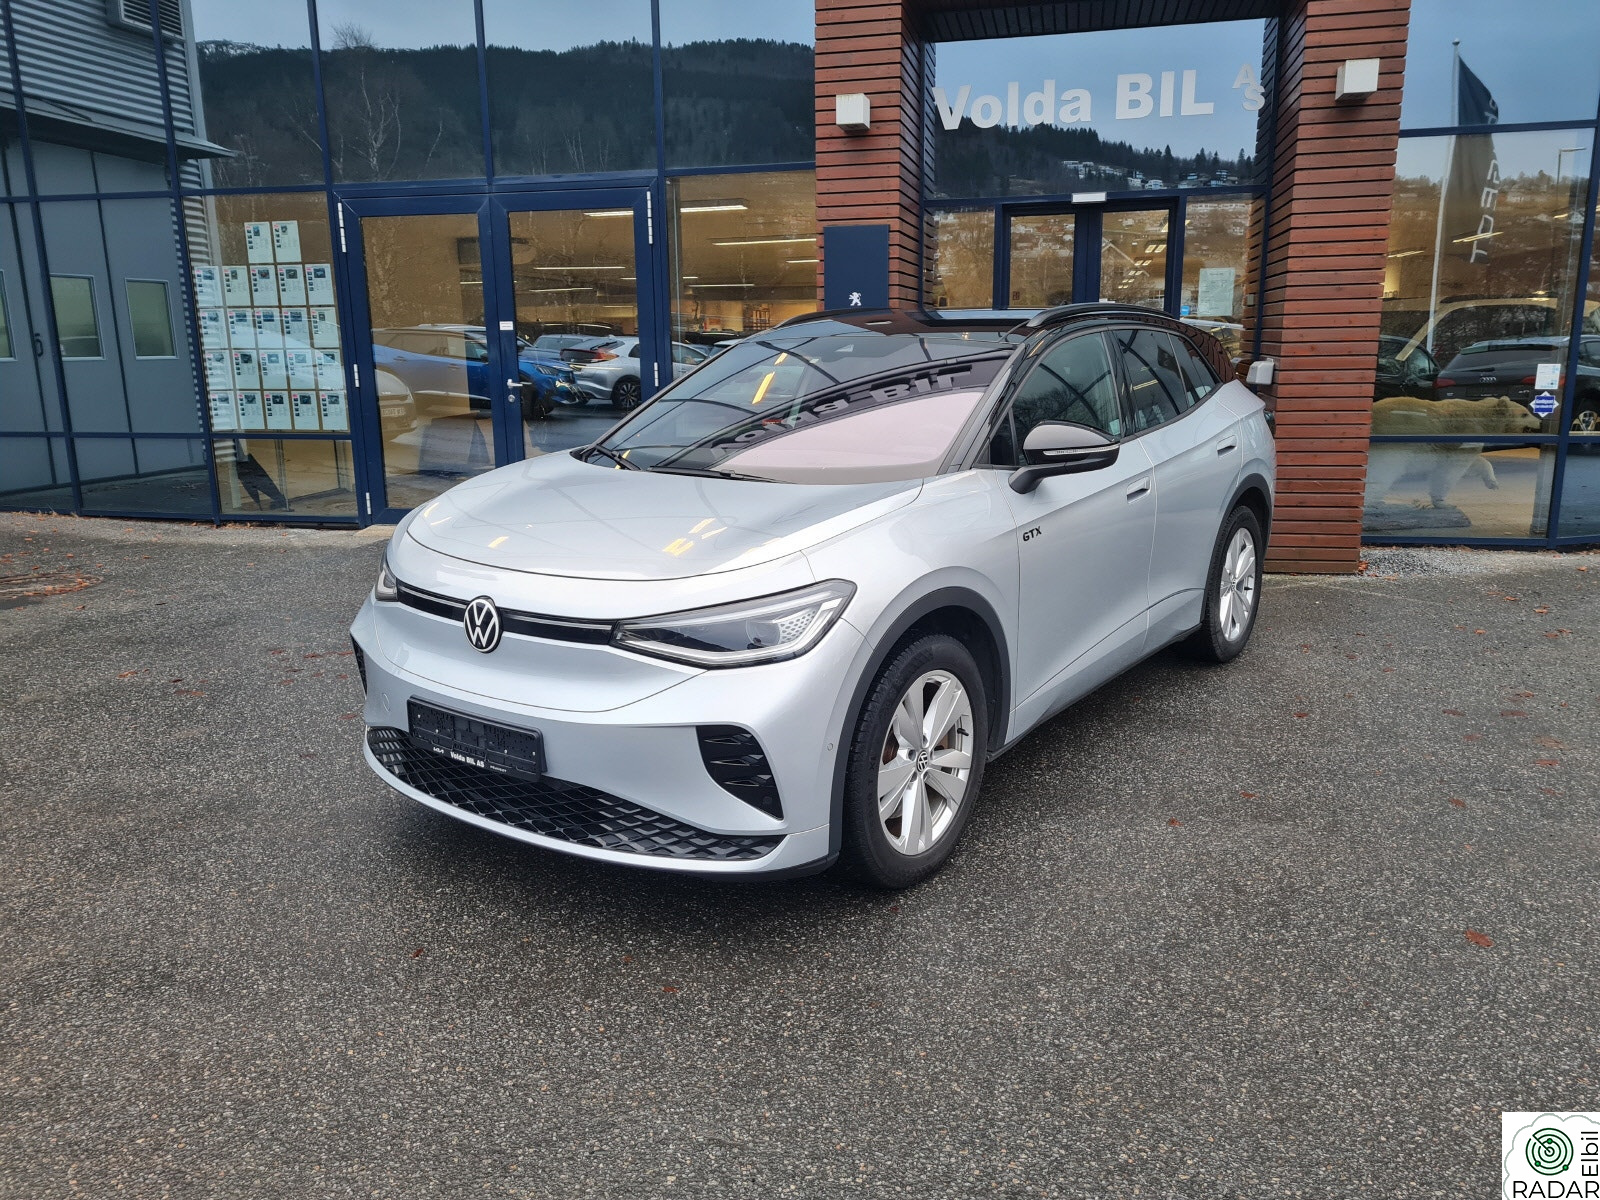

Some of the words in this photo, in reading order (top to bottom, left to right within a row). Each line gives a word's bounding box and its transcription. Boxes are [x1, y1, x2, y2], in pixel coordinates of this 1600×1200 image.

[932, 79, 1092, 131] Volda
[1115, 69, 1215, 120] BIL
[1023, 526, 1042, 541] GTX
[451, 752, 465, 762] Volda
[466, 757, 476, 766] BIL
[476, 760, 485, 768] AS
